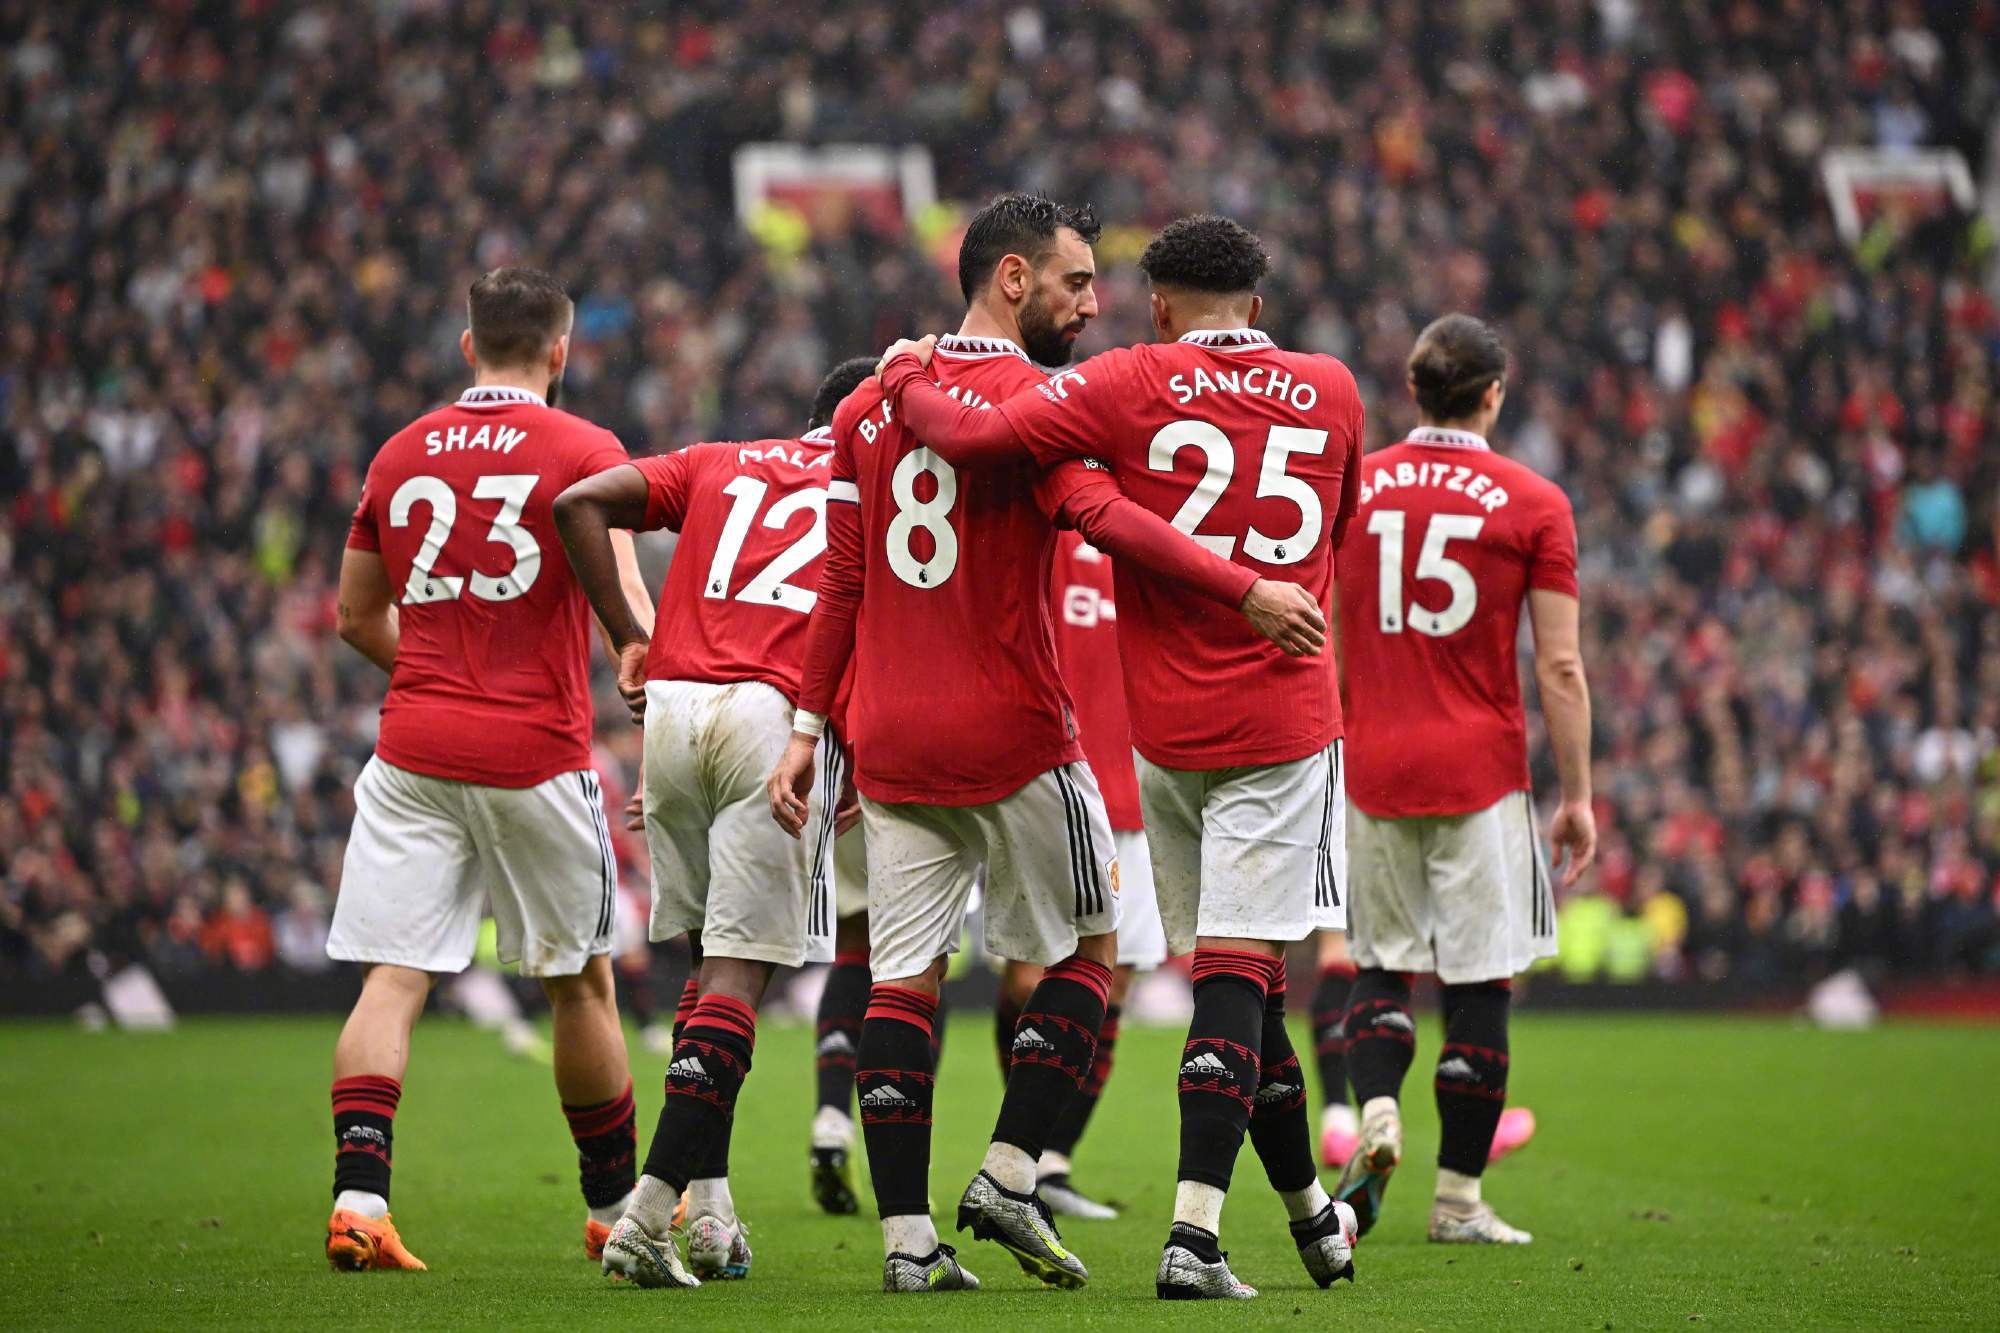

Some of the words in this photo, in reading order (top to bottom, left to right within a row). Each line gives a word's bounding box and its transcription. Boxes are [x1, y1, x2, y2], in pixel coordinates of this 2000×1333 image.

[1169, 367, 1317, 411] SANCHO
[424, 424, 527, 456] SHAW
[1148, 419, 1329, 564] 25
[389, 474, 541, 605] 23
[886, 446, 958, 589] 8
[703, 475, 829, 615] 12
[1367, 510, 1485, 637] 15
[666, 1067, 715, 1085] adidas
[1180, 1065, 1235, 1079] adidas
[860, 1096, 917, 1107] adidas
[343, 1130, 386, 1146] adidas
